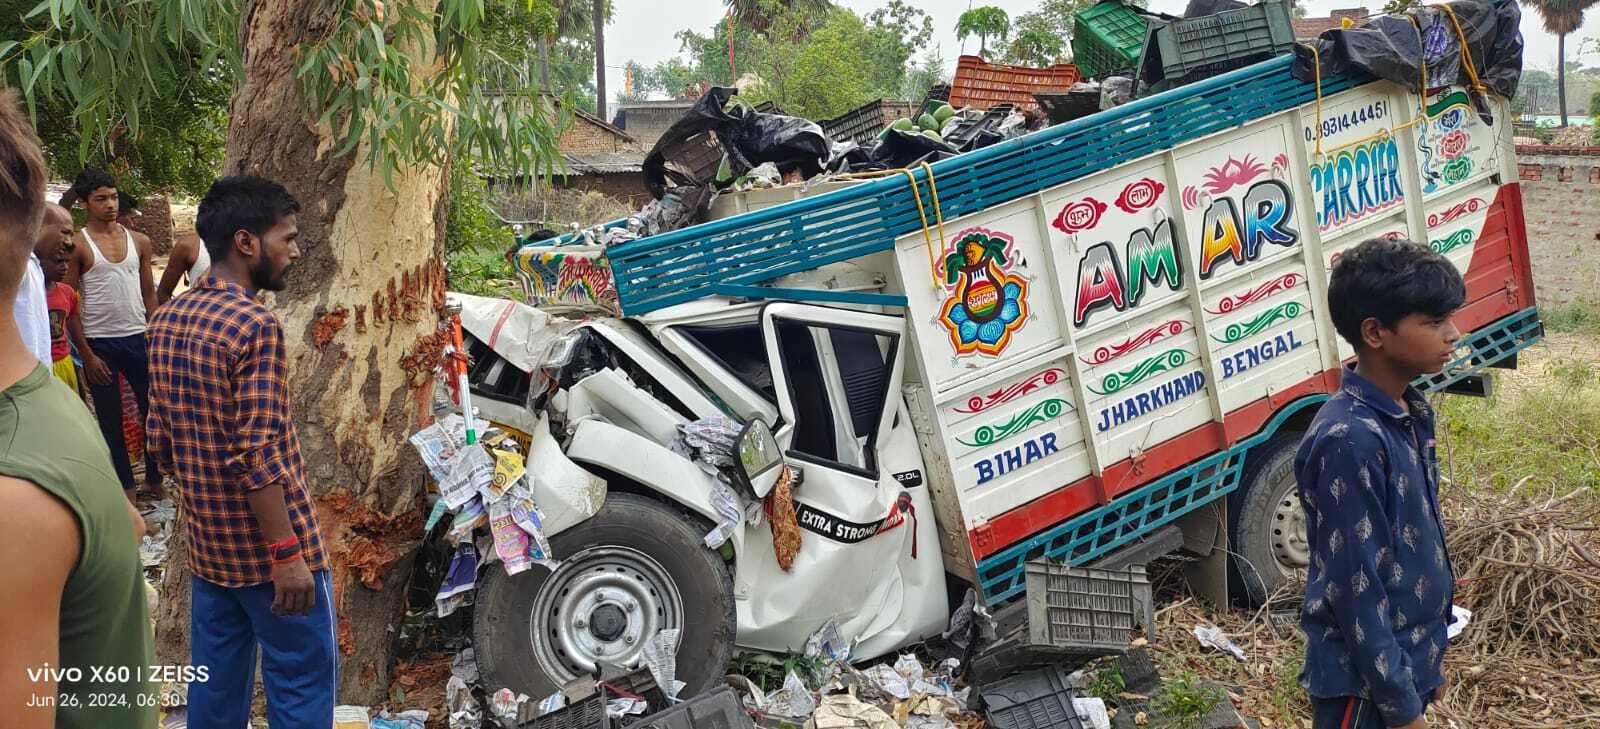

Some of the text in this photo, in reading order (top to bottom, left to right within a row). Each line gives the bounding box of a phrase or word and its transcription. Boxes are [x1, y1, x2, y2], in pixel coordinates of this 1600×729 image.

[1131, 187, 1149, 203] लाभ
[1220, 330, 1302, 380] BENGAL
[1097, 371, 1206, 432] JHARKHAND
[974, 432, 1059, 485] BIHAR
[801, 510, 878, 540] EXTRA STRONG
